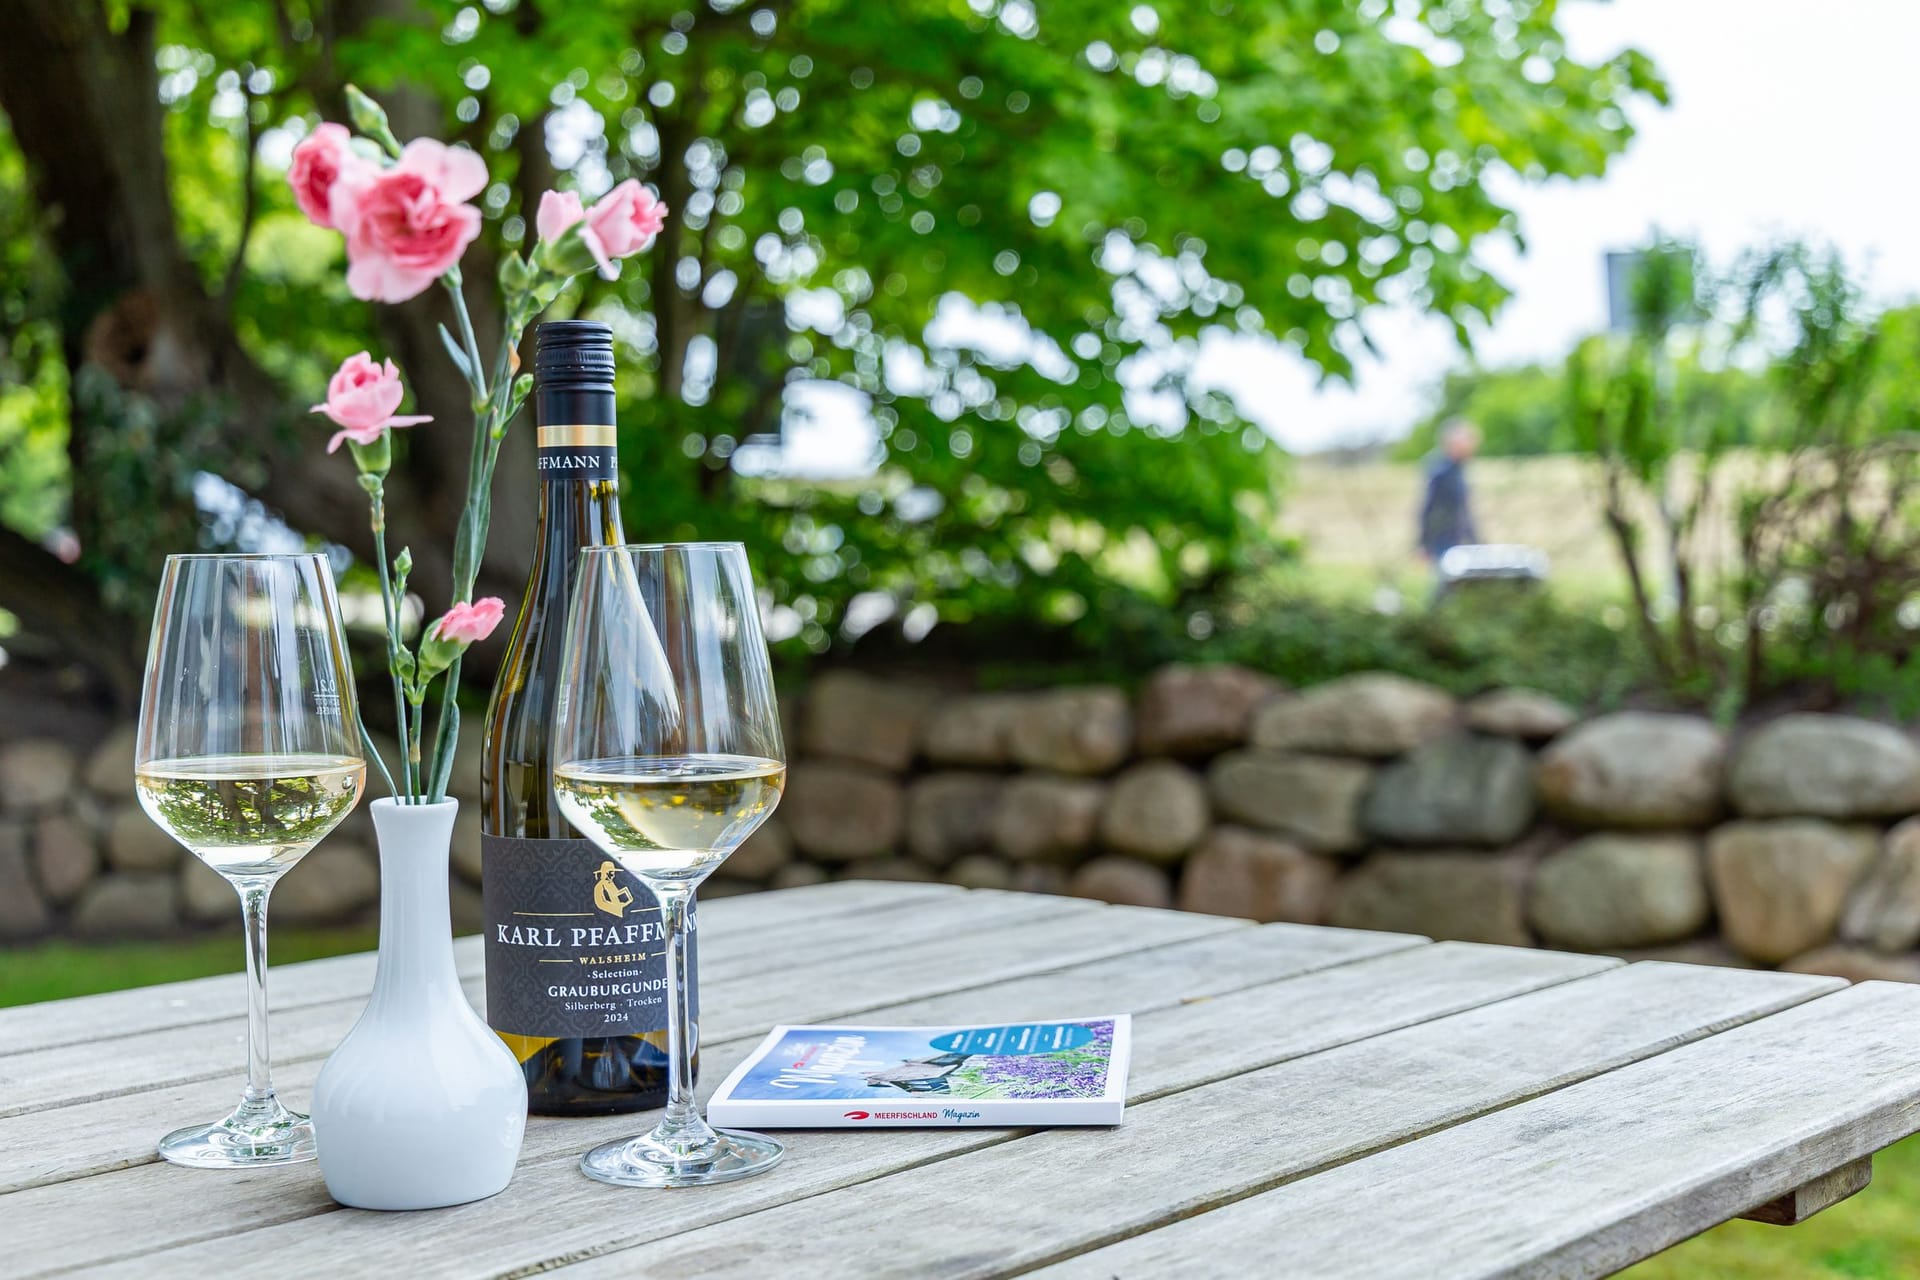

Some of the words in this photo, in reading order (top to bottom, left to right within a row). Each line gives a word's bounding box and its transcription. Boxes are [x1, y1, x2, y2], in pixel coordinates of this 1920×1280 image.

[497, 924, 562, 947] KARL
[579, 952, 647, 966] WALSHEIM
[548, 977, 668, 998] GRAUBURGUNDE
[564, 1000, 616, 1011] Silberberg
[627, 996, 662, 1007] Trocken
[604, 1012, 629, 1023] 2024
[874, 1111, 938, 1120] MEERFISCHLAND
[942, 1108, 980, 1122] Magazin
